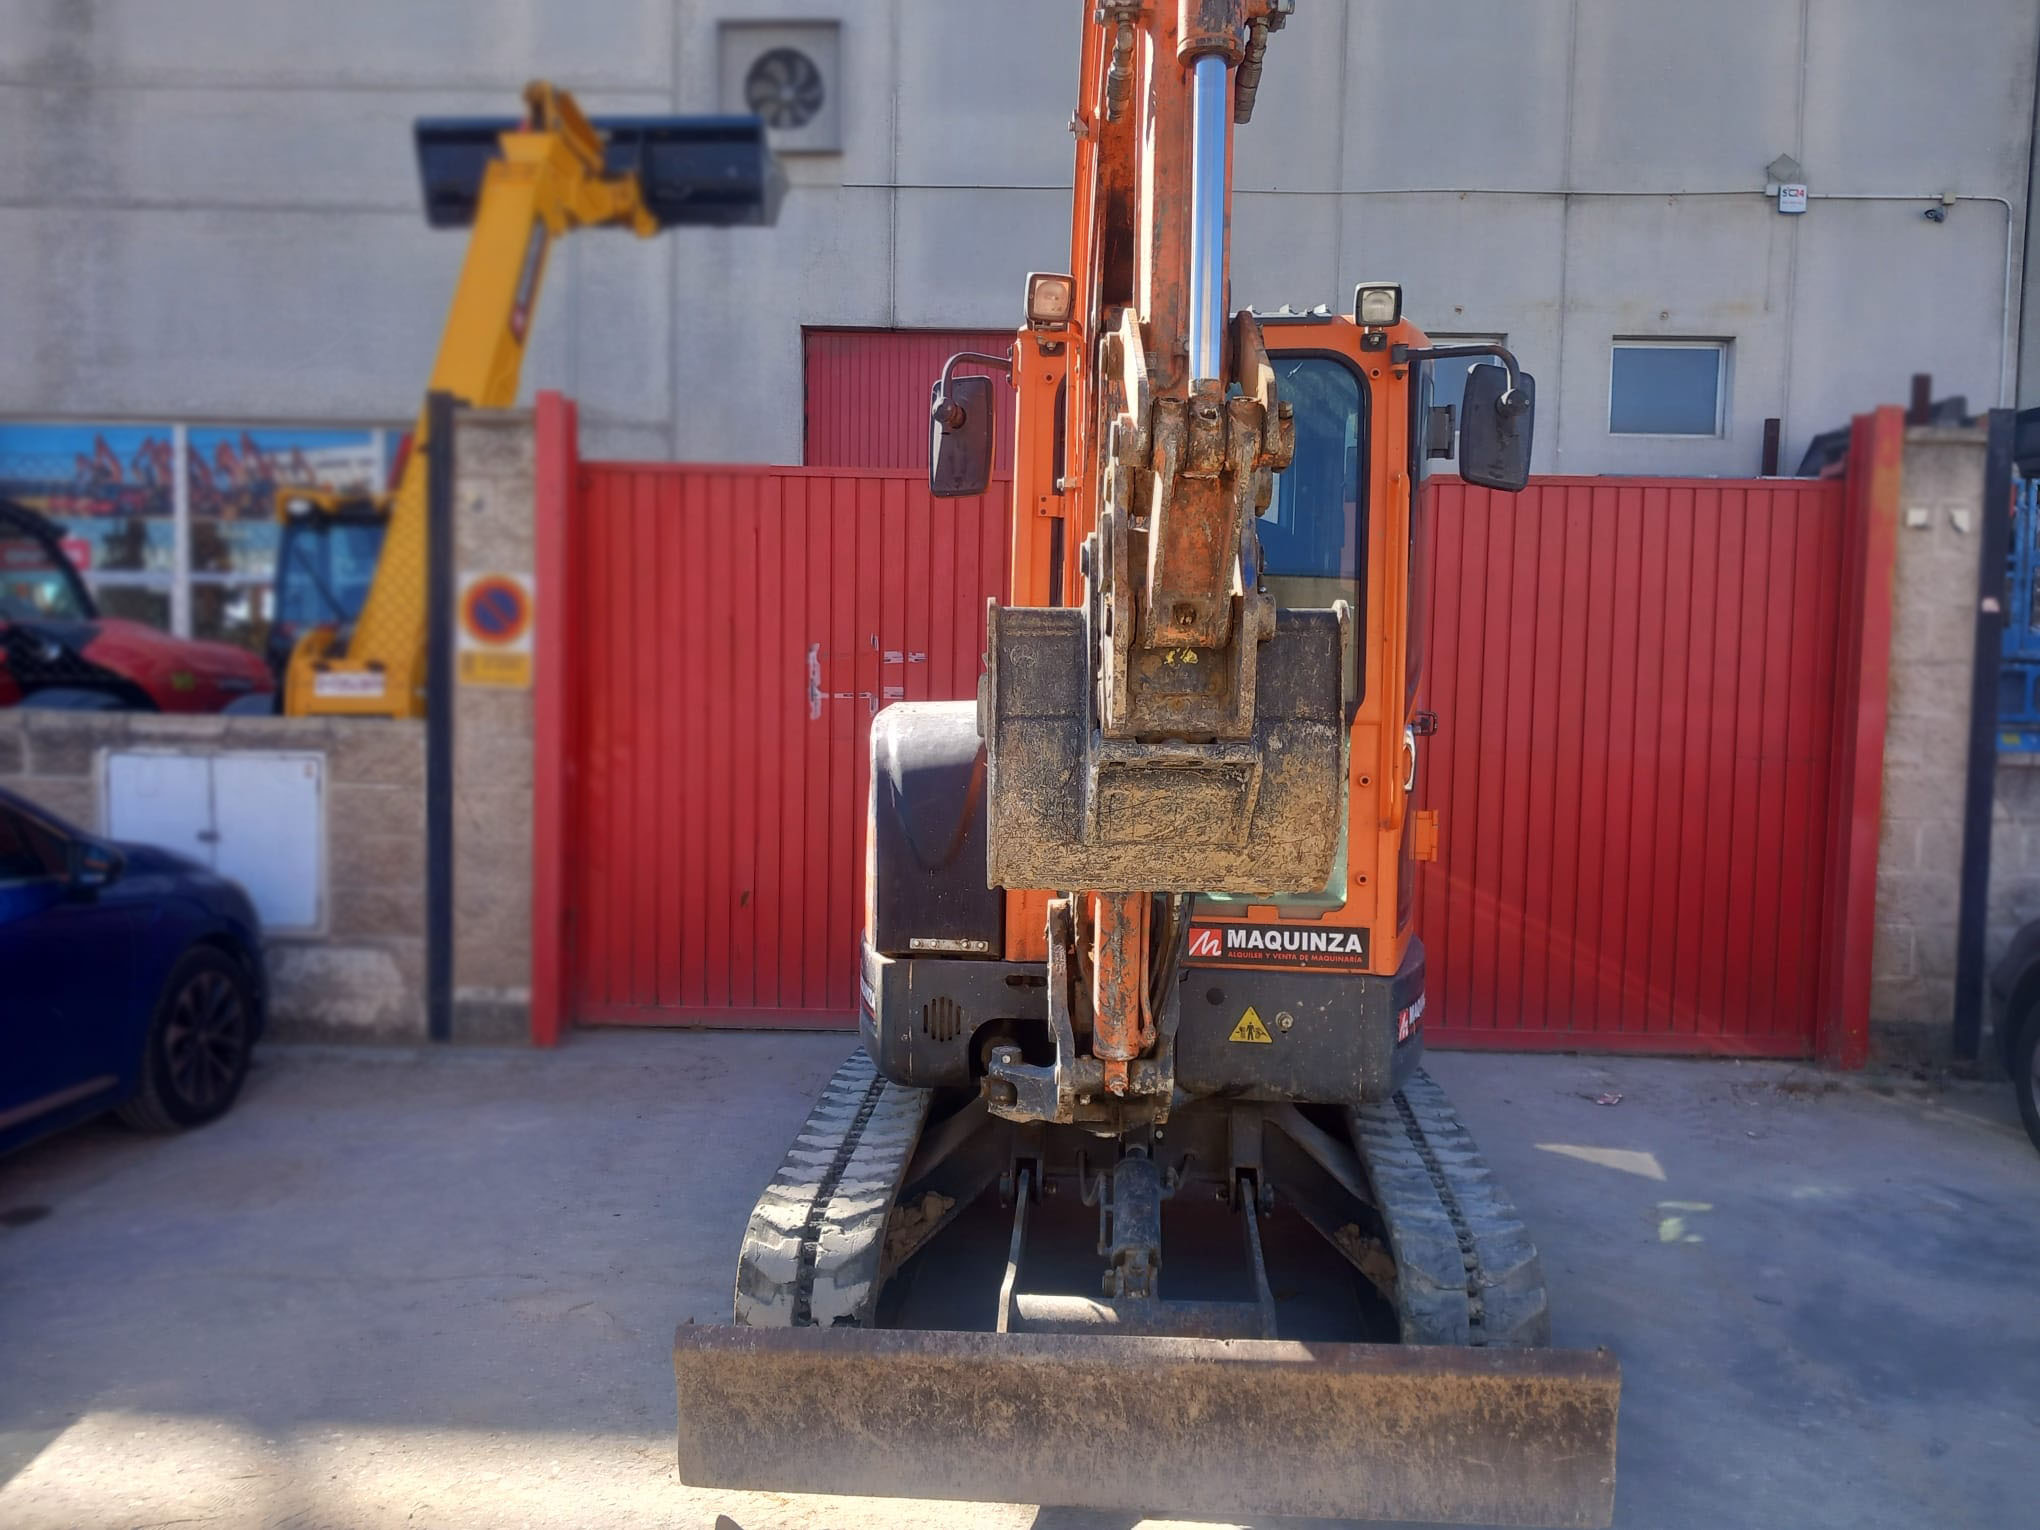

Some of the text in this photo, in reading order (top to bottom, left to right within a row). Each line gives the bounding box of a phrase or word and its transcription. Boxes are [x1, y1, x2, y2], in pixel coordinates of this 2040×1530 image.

[1227, 929, 1363, 953] MAQUINZA
[1228, 951, 1263, 959] ALQUILER
[1273, 952, 1297, 960] VENTA
[1299, 954, 1309, 962] DE
